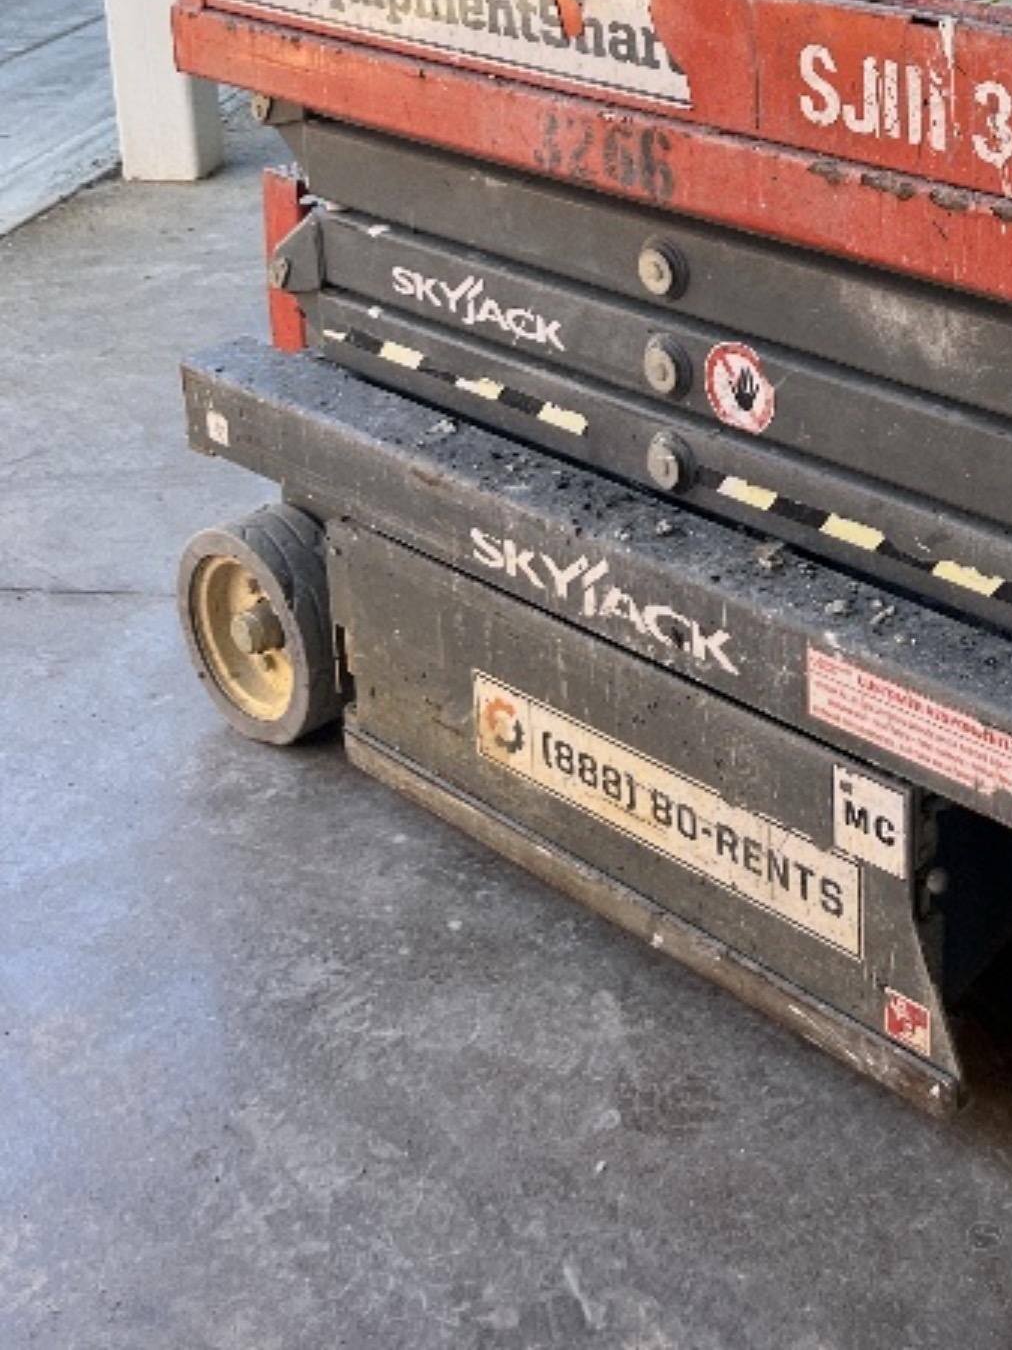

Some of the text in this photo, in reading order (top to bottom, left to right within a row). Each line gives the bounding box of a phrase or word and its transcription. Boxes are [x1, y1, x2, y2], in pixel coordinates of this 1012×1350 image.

[392, 266, 565, 350] SKYJACK
[469, 526, 740, 675] SKYJACK
[541, 730, 844, 917] (888) 80-RENTS
[844, 799, 896, 847] MC
